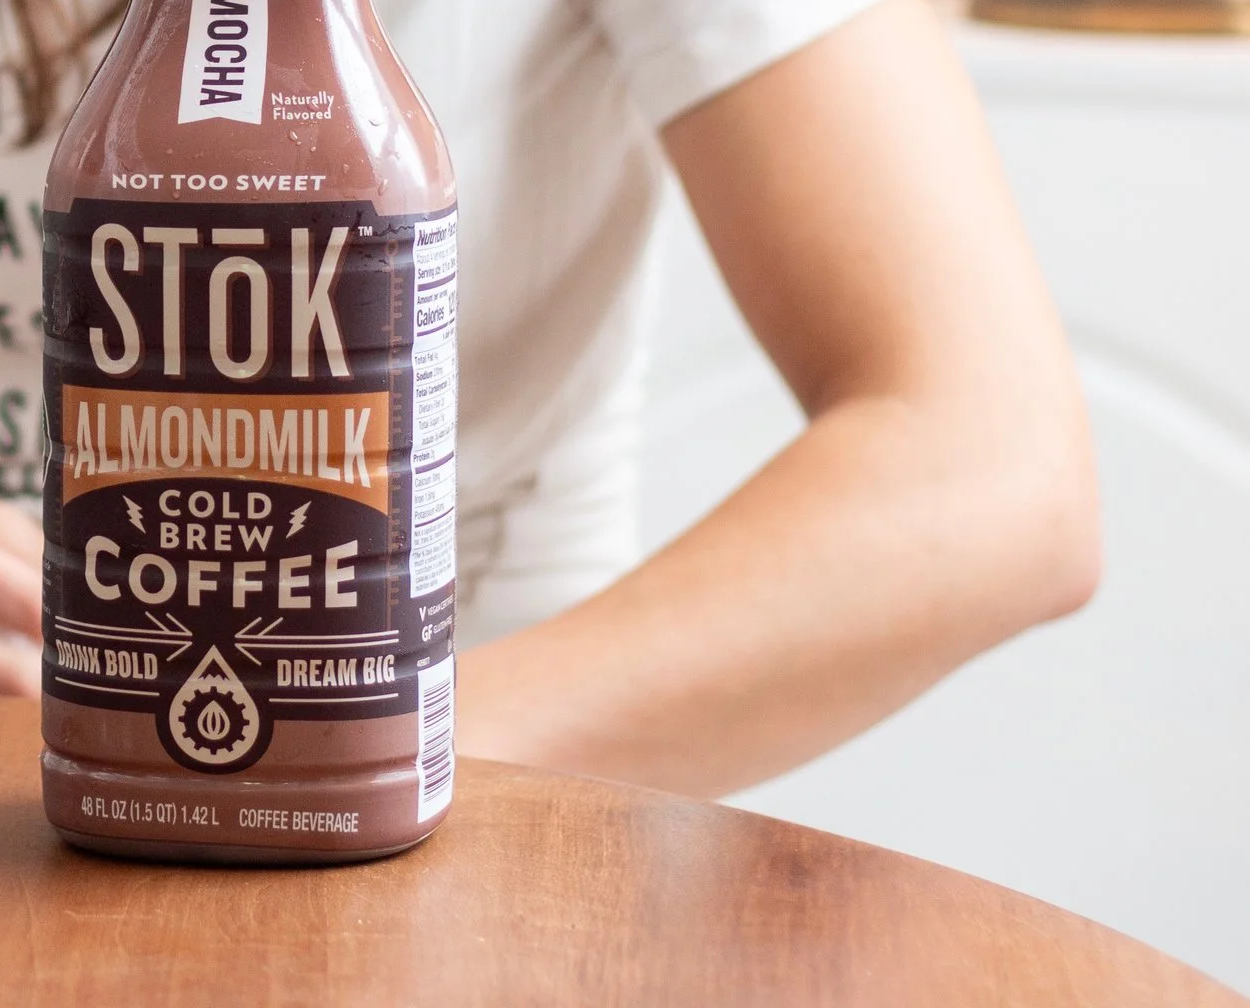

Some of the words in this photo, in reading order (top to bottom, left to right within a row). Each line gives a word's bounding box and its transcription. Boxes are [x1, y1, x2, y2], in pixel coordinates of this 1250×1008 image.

[271, 91, 334, 109] Naturally
[273, 107, 332, 120] Flavored
[111, 174, 164, 190] NOT
[171, 174, 228, 191] TOO
[236, 174, 326, 192] SWEET
[416, 305, 444, 327] Calories
[73, 401, 371, 488] ALMONDMILK
[159, 490, 272, 520] COLD
[159, 522, 274, 552] BREW
[84, 535, 358, 609] COFFEE
[56, 639, 101, 675] DRINK
[104, 649, 158, 680] BOLD
[277, 657, 359, 687] DREAM
[362, 654, 395, 684] BIG
[81, 795, 93, 816] 48
[95, 798, 109, 818] FL
[111, 800, 127, 820] OZ
[130, 801, 153, 823] (1.5
[156, 803, 177, 825] QT)
[181, 806, 208, 825] 1.42
[212, 807, 220, 825] L
[239, 808, 288, 830] COFFEE
[293, 812, 359, 833] BEVERAGE
